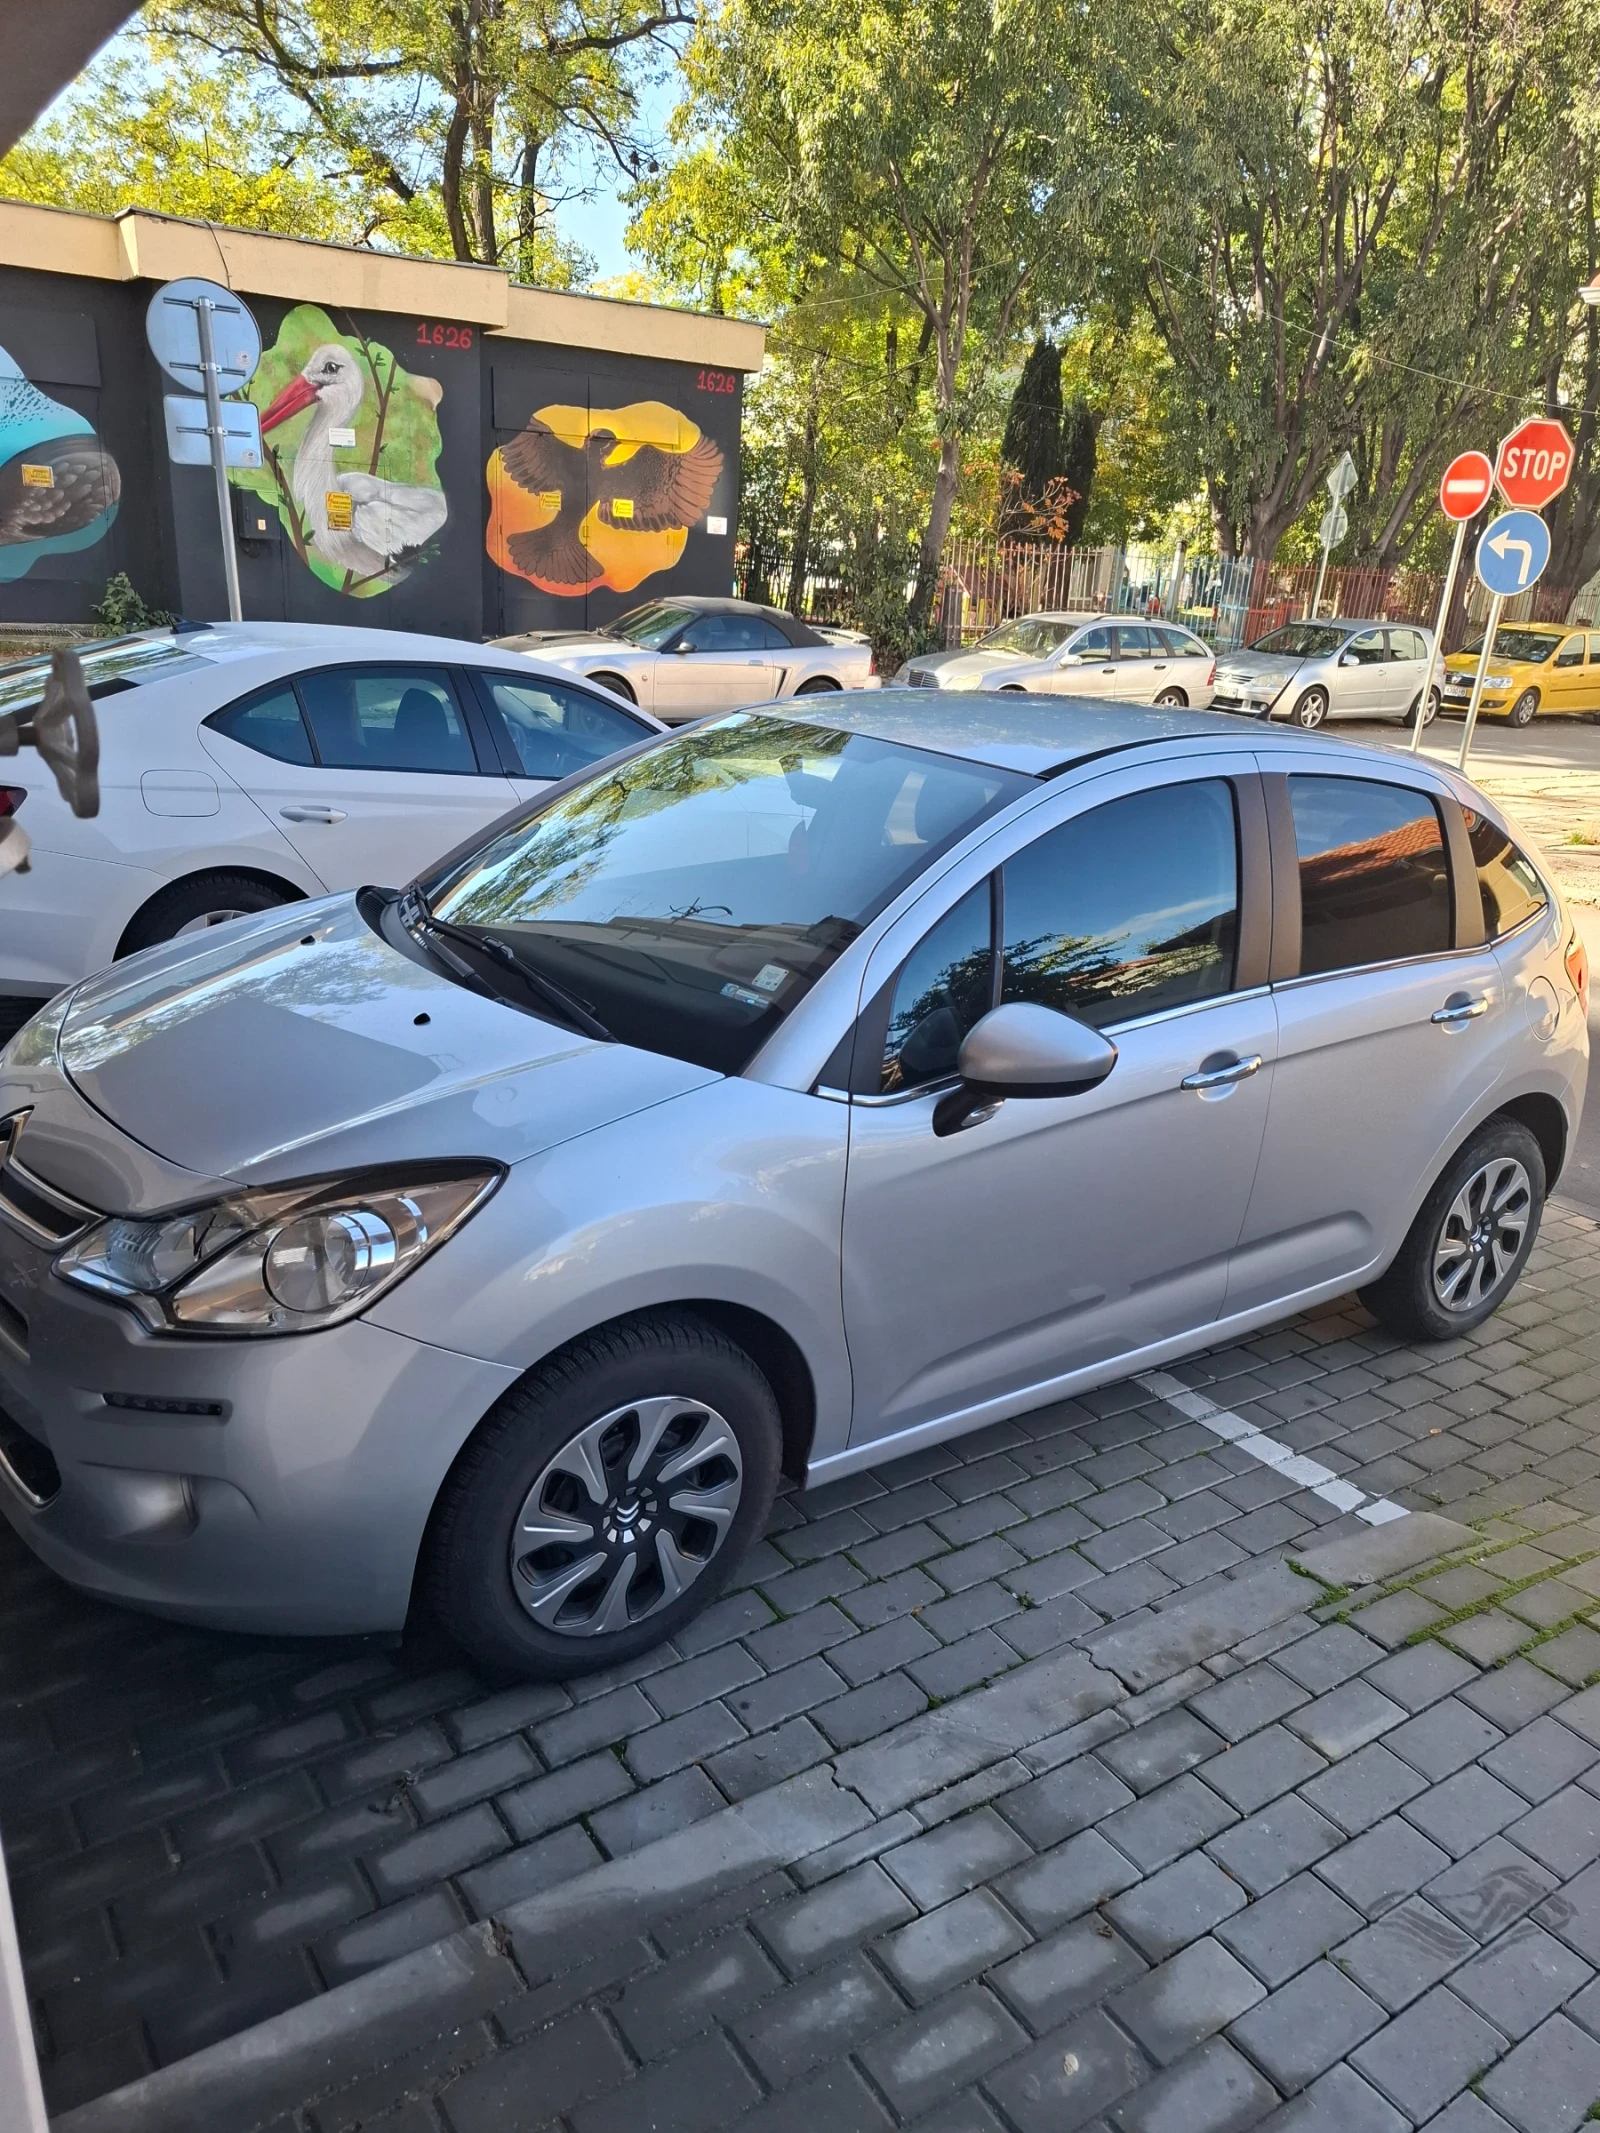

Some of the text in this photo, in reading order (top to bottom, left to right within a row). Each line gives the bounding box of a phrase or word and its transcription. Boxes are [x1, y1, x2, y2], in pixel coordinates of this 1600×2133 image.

[416, 323, 473, 349] 1626
[696, 370, 736, 393] 1626
[1503, 447, 1566, 481] STOP
